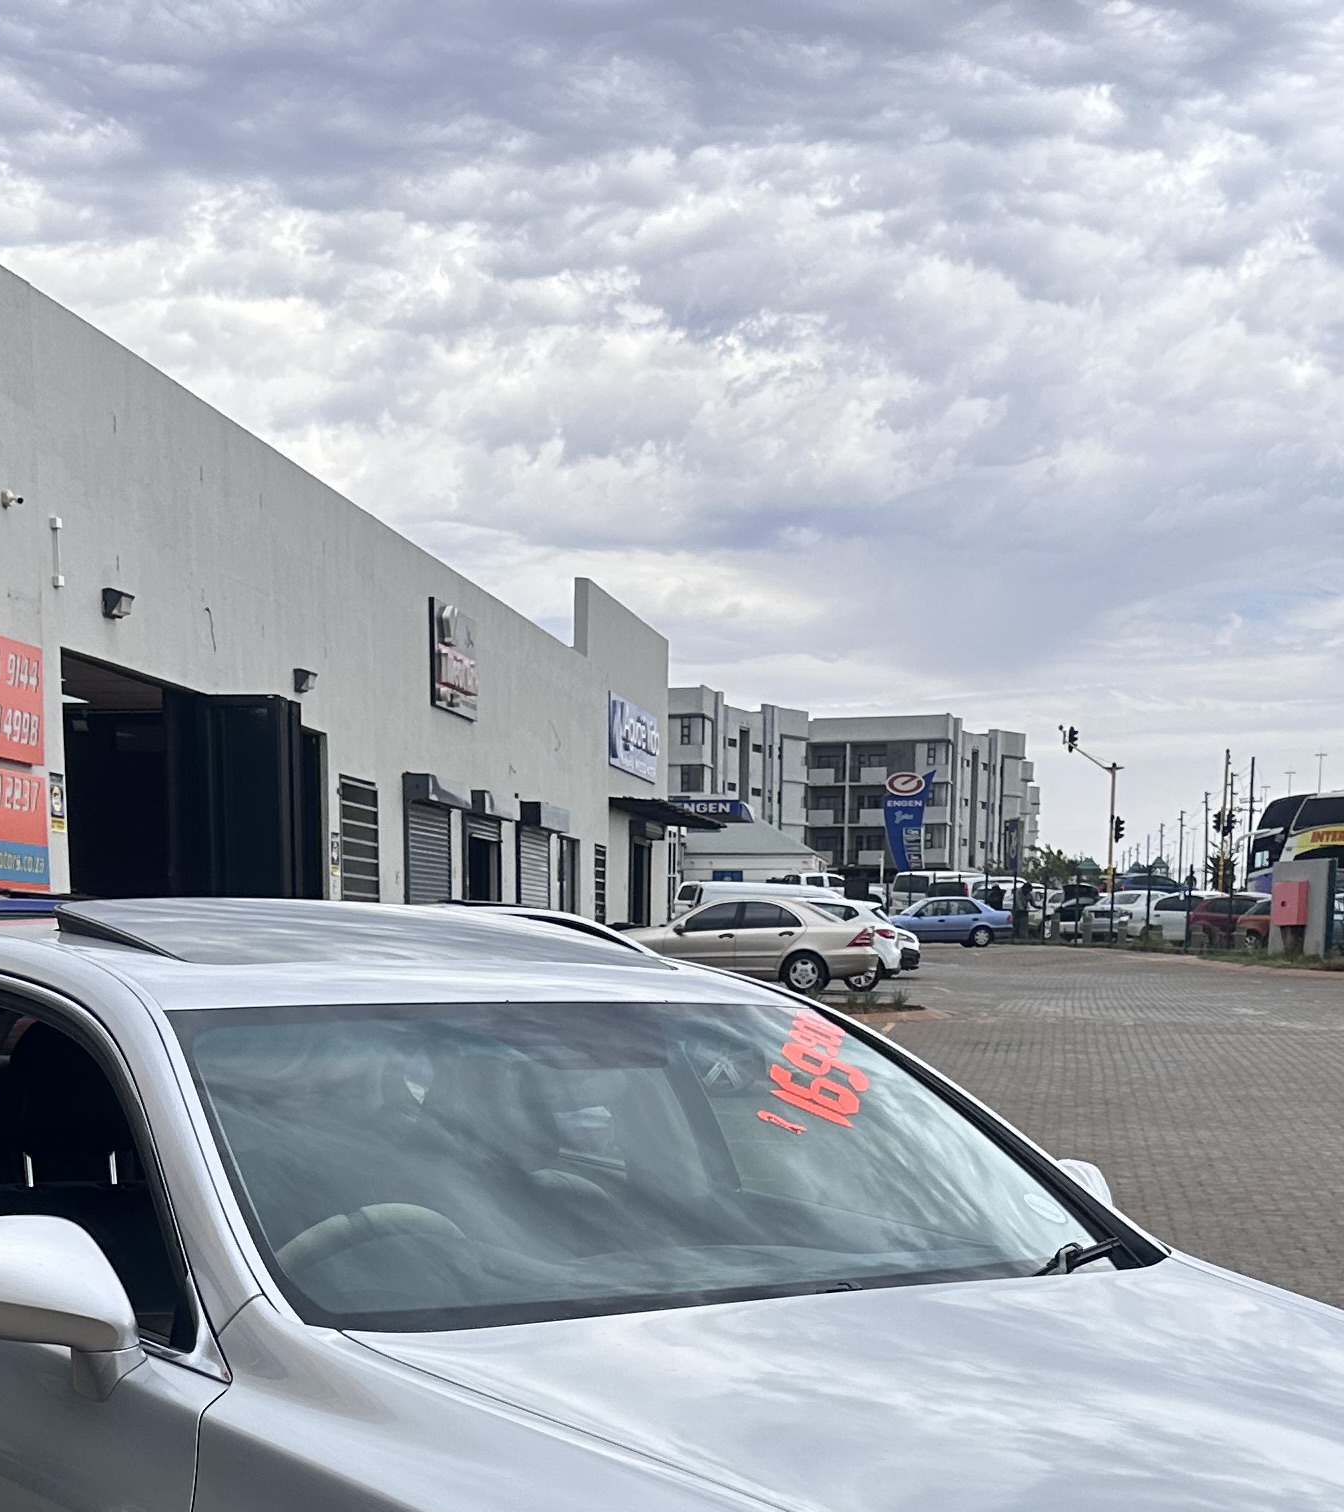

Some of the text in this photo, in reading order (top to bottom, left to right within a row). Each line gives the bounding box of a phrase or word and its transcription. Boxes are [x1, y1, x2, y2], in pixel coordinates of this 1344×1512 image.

[6, 653, 39, 693] 9144
[3, 708, 40, 746] 4998
[4, 776, 40, 812] 2237
